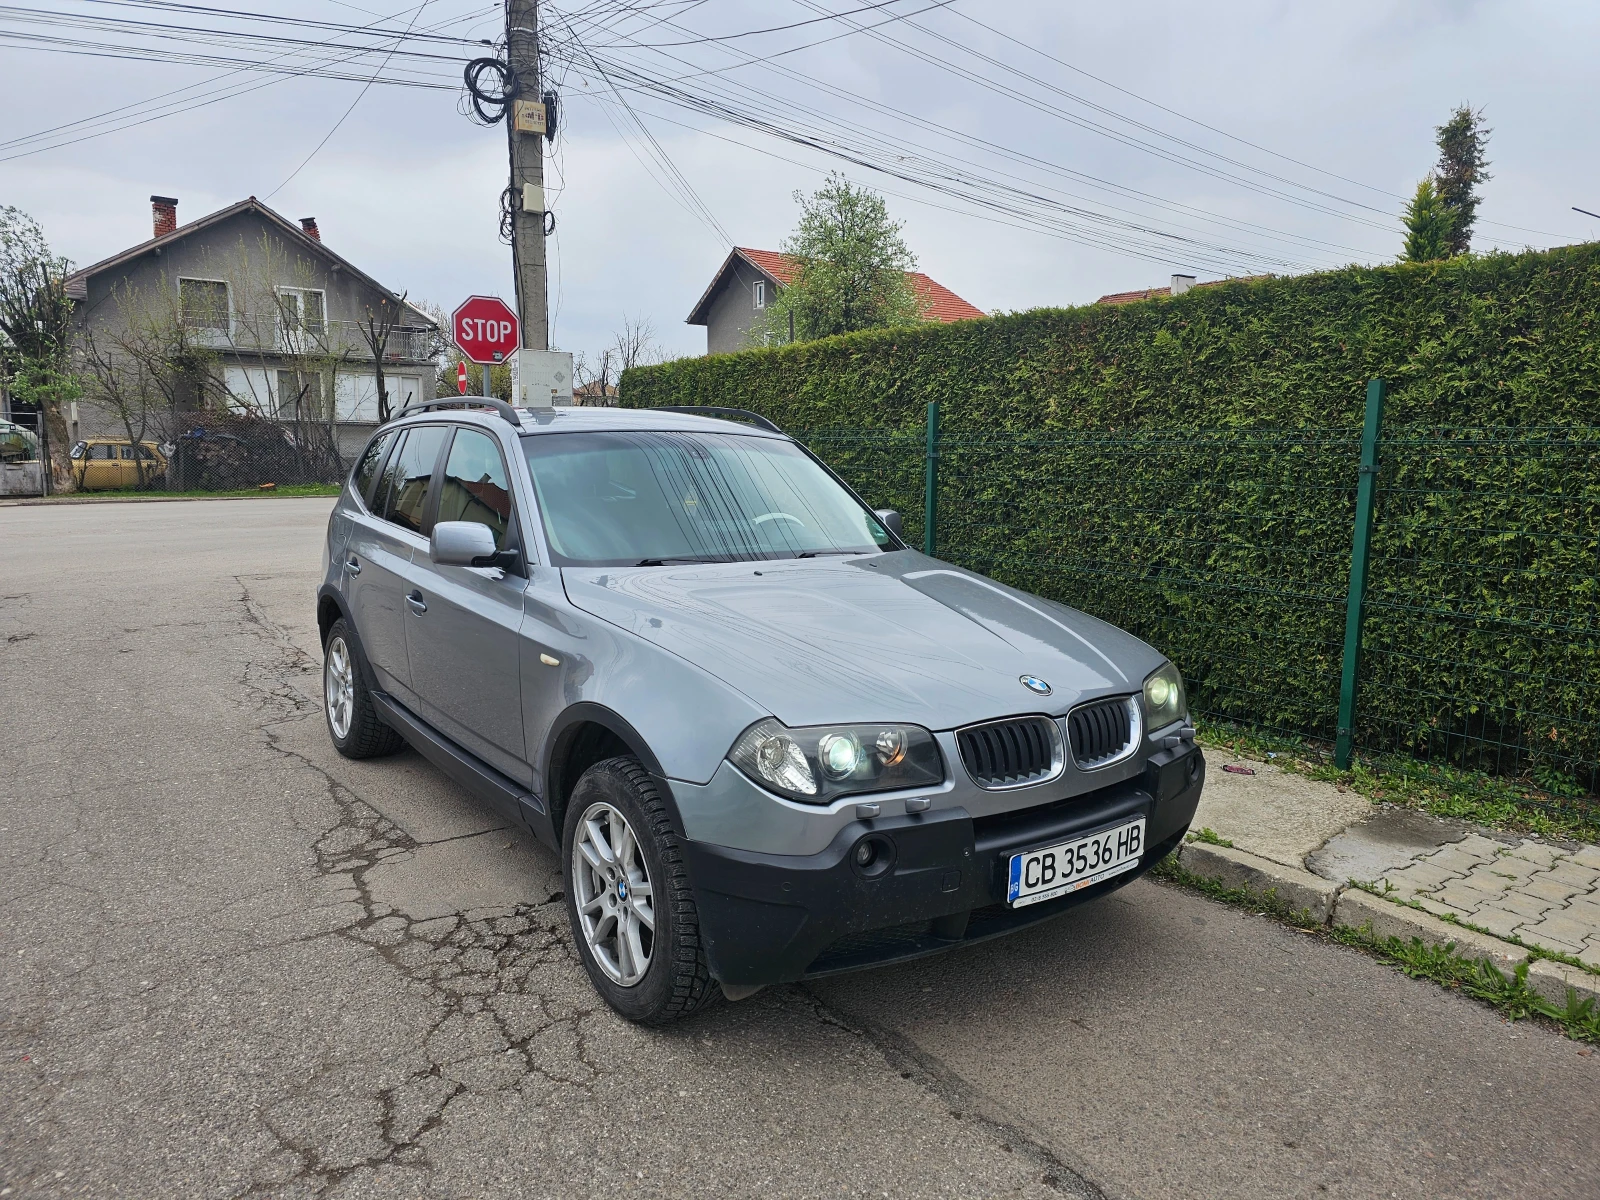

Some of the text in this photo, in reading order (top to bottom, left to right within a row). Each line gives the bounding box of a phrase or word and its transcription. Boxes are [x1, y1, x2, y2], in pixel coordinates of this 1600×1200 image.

[461, 317, 512, 343] STOP
[1024, 824, 1140, 889] CB 3536 HB
[1010, 881, 1019, 894] BG
